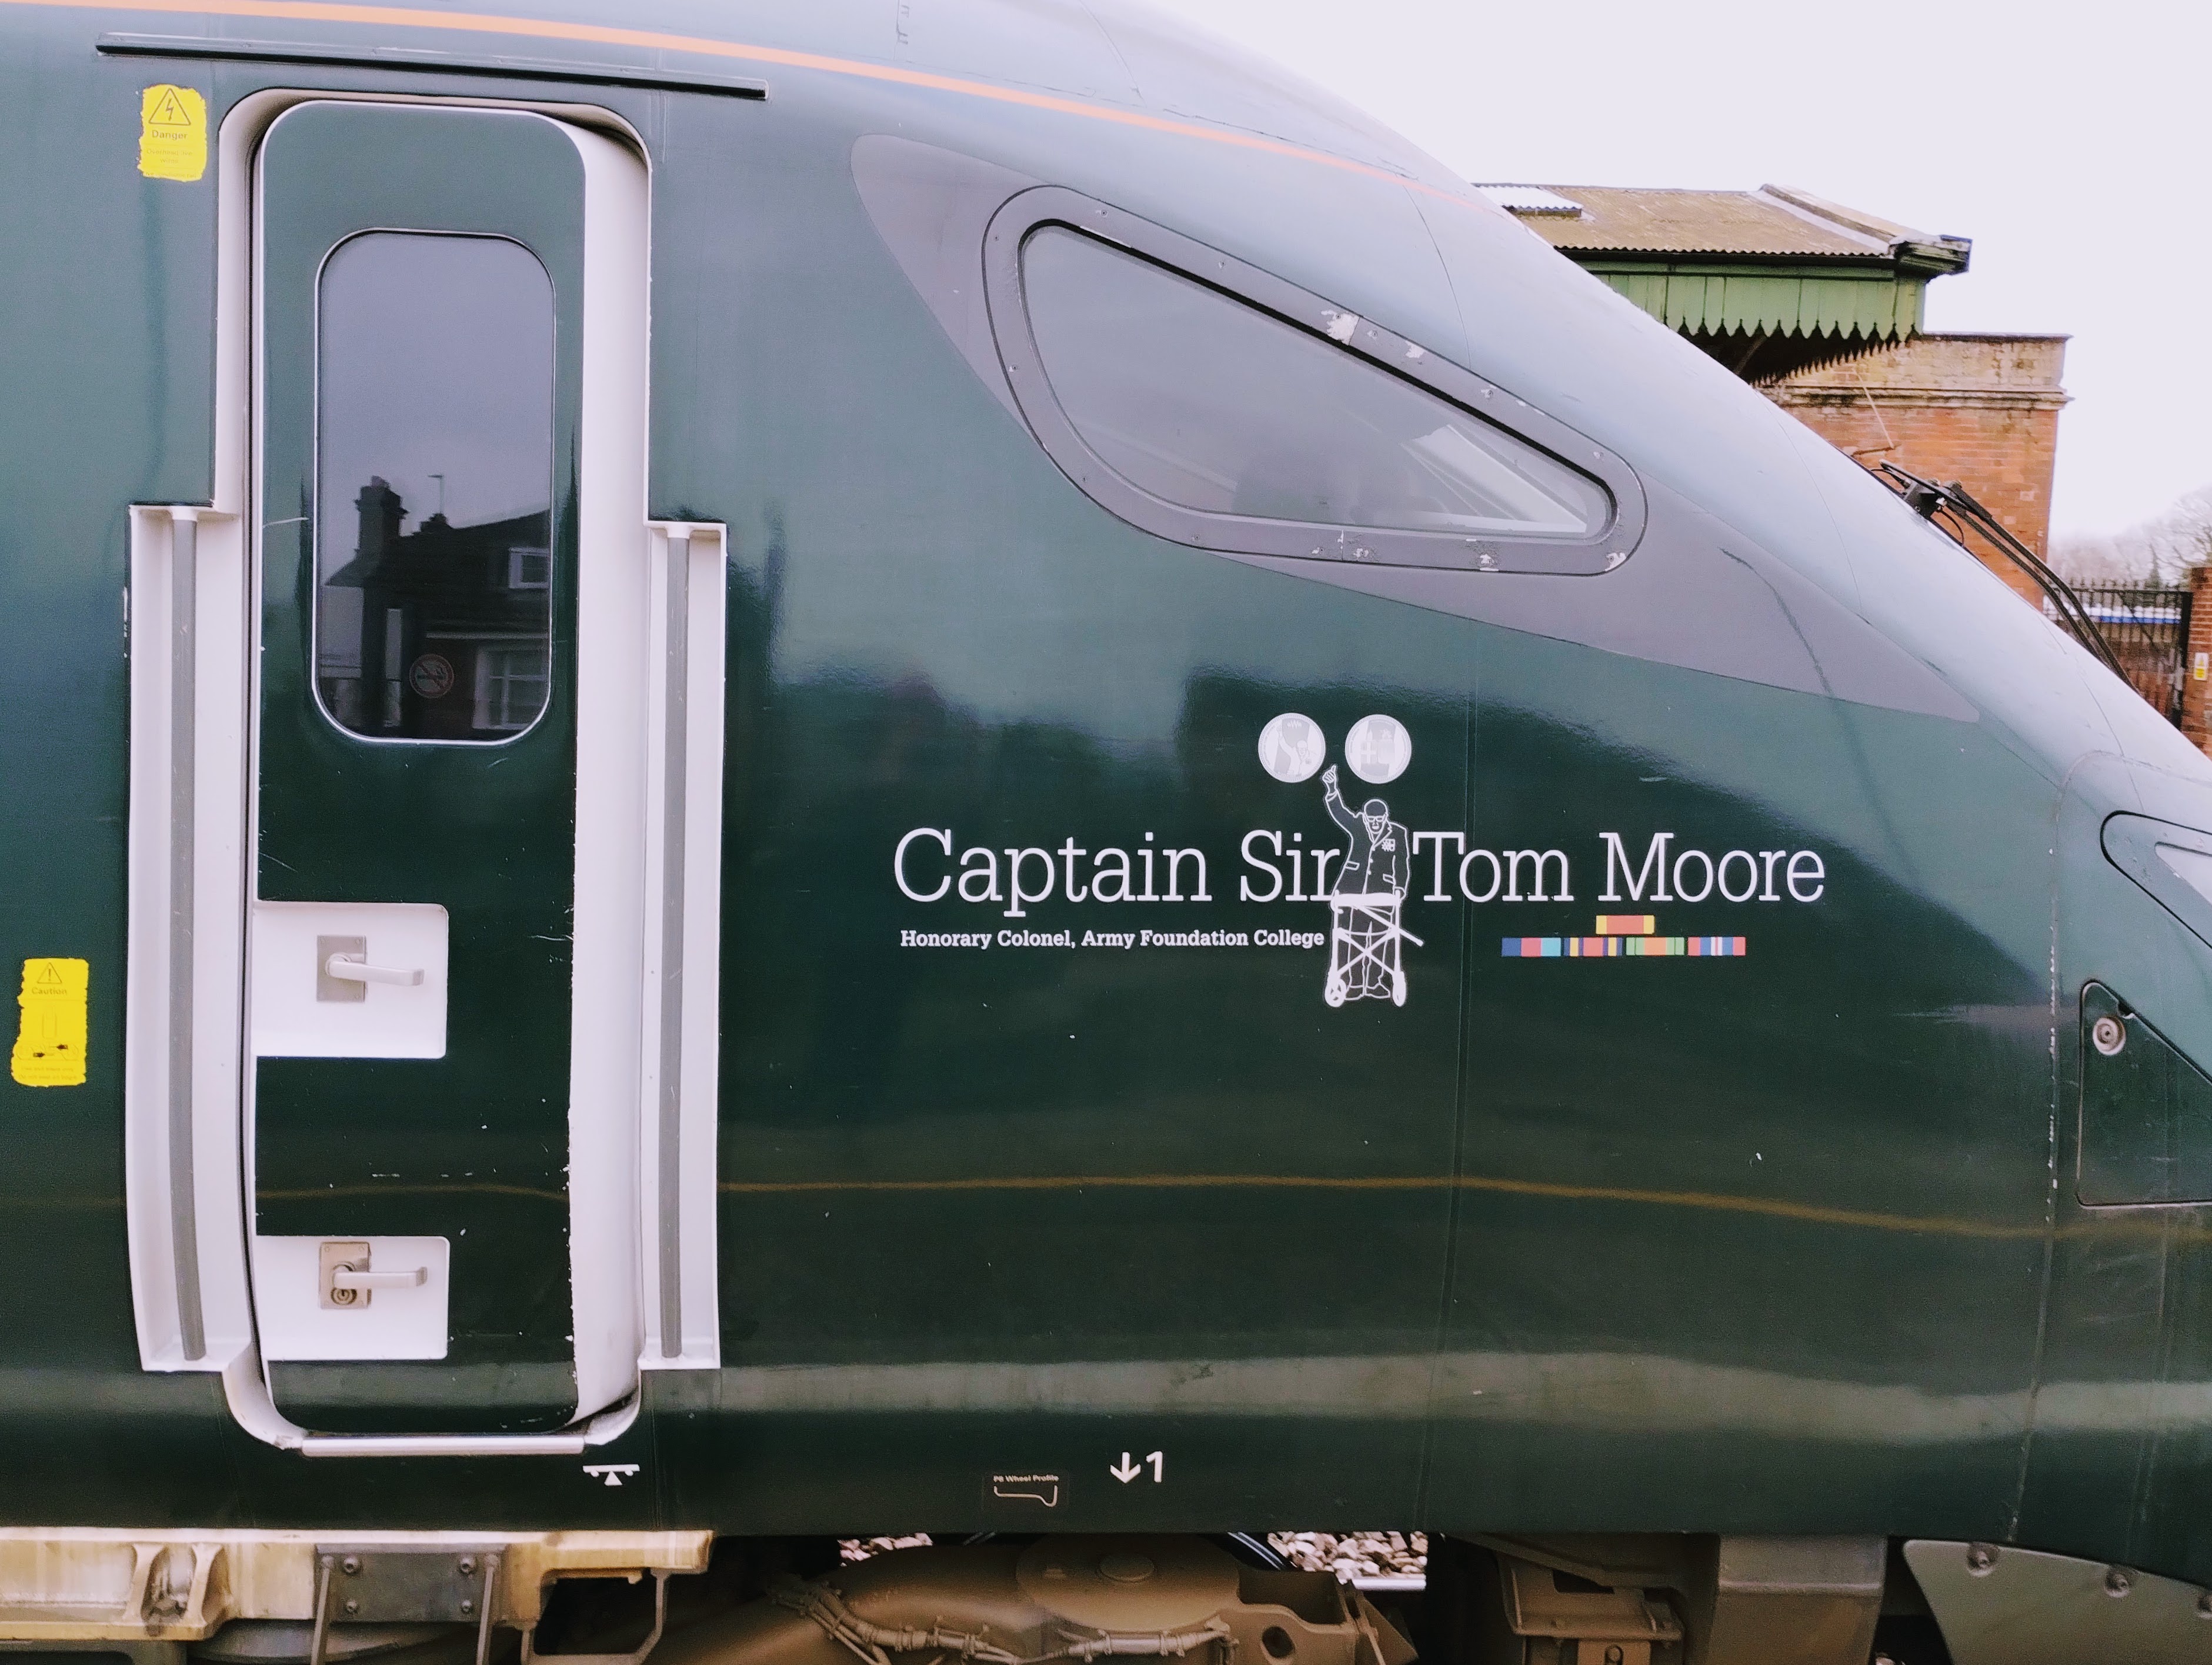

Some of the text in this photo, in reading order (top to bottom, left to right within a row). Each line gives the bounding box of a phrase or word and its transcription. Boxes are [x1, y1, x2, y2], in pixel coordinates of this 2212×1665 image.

[152, 129, 188, 141] Danger
[894, 828, 1826, 917] Captain Sir Tom Moore
[900, 929, 1324, 950] Honorary Colonel, Army Foundation College
[32, 987, 68, 995] Caution
[1146, 1451, 1163, 1483] 1
